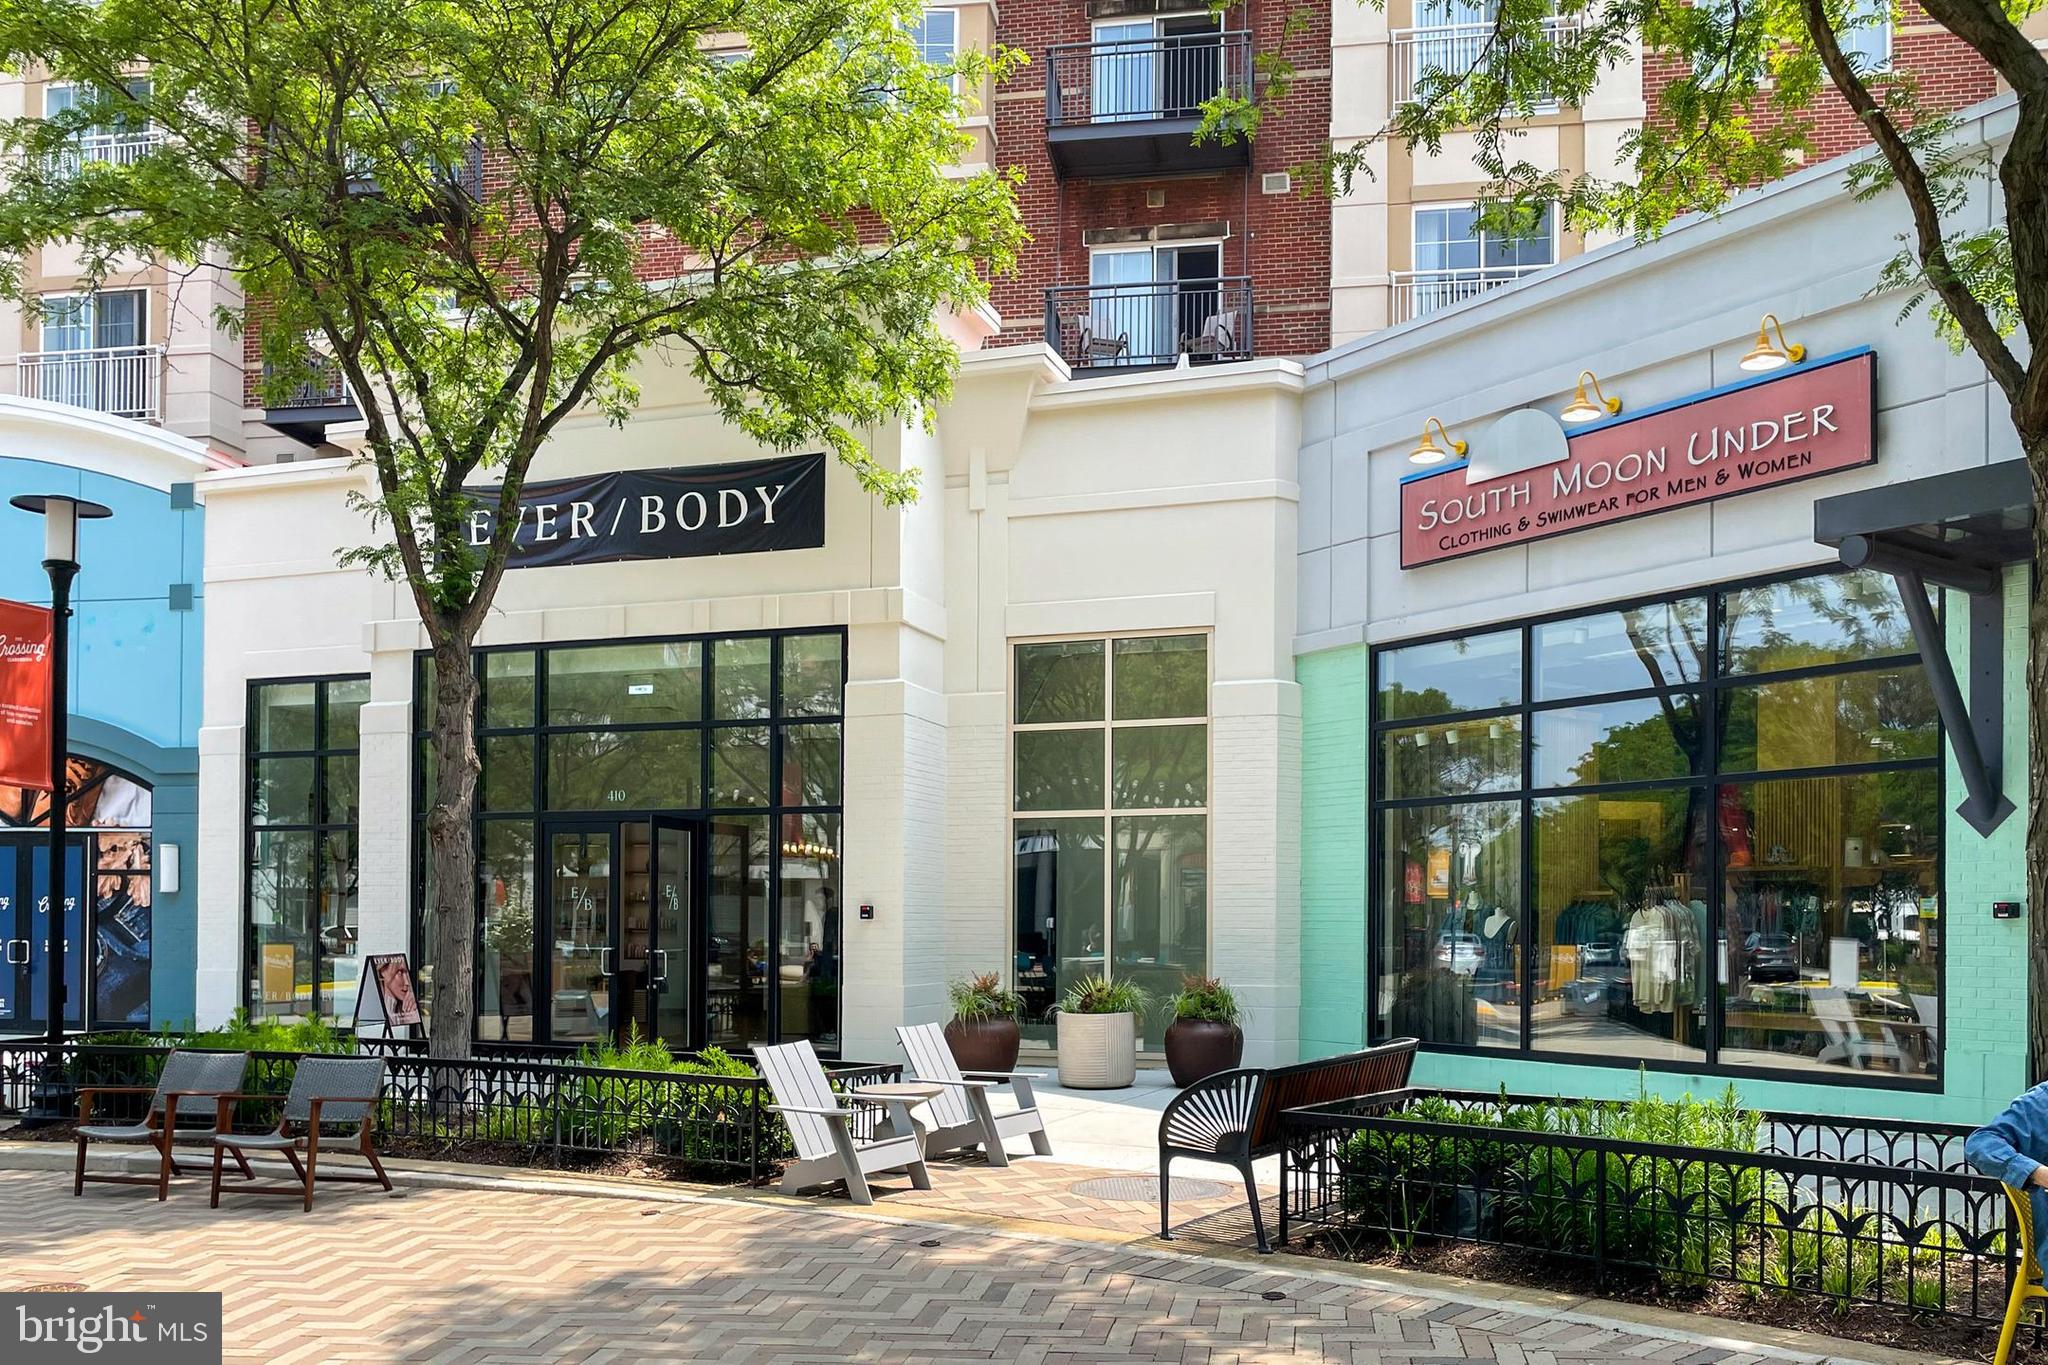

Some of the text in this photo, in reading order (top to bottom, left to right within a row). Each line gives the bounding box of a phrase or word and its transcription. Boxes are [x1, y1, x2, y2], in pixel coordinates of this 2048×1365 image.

[1418, 404, 1839, 531] SOUTH MOON UNDER
[1438, 450, 1812, 551] CLOTHING & SWIMWEAR FOR MEN & WOMEN
[607, 789, 626, 802] 410
[571, 886, 593, 911] E/B
